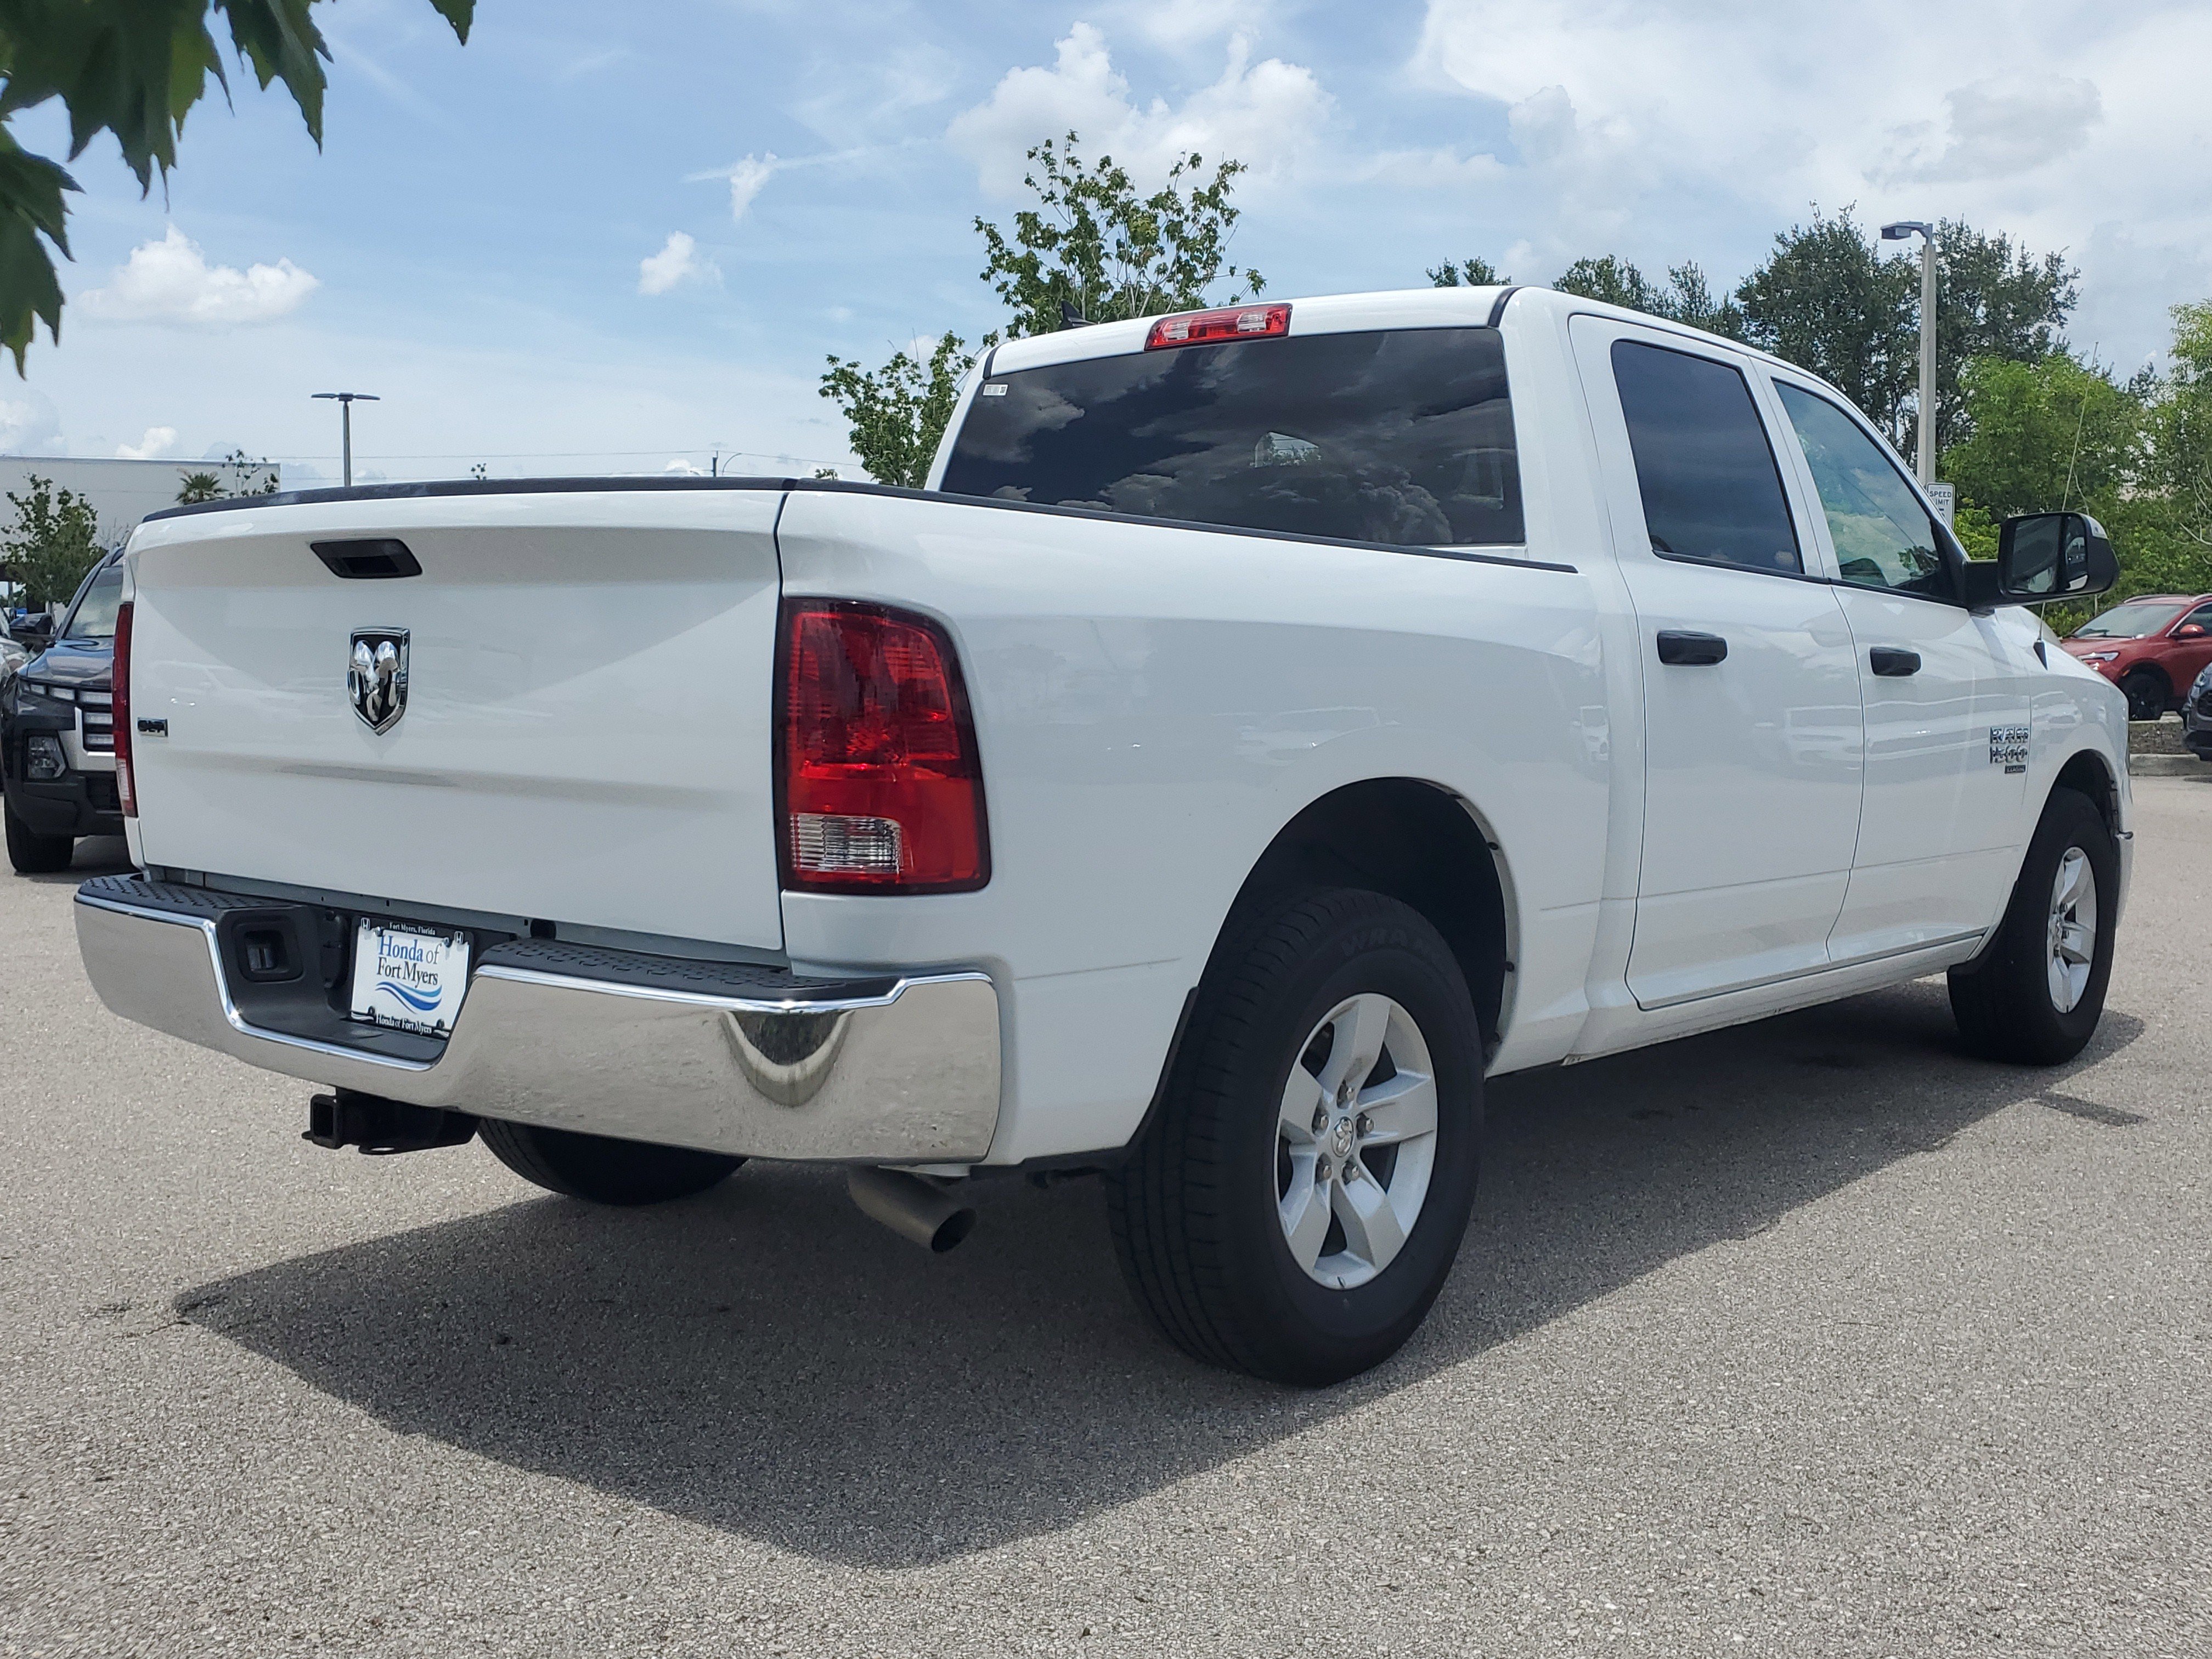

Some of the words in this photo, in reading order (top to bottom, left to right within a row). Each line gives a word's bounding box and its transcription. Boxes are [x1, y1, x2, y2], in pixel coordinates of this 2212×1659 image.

[1990, 727, 2029, 744] RAM
[1990, 745, 2028, 763] 1500
[390, 922, 400, 930] Fort
[418, 926, 436, 935] Florida
[379, 934, 423, 962] Honda
[426, 943, 442, 964] of
[377, 957, 401, 979] Fort
[403, 961, 438, 988] Myers
[376, 1013, 394, 1026] Honda
[395, 1020, 401, 1029] of
[402, 1018, 414, 1030] Fort
[415, 1021, 432, 1036] Myers
